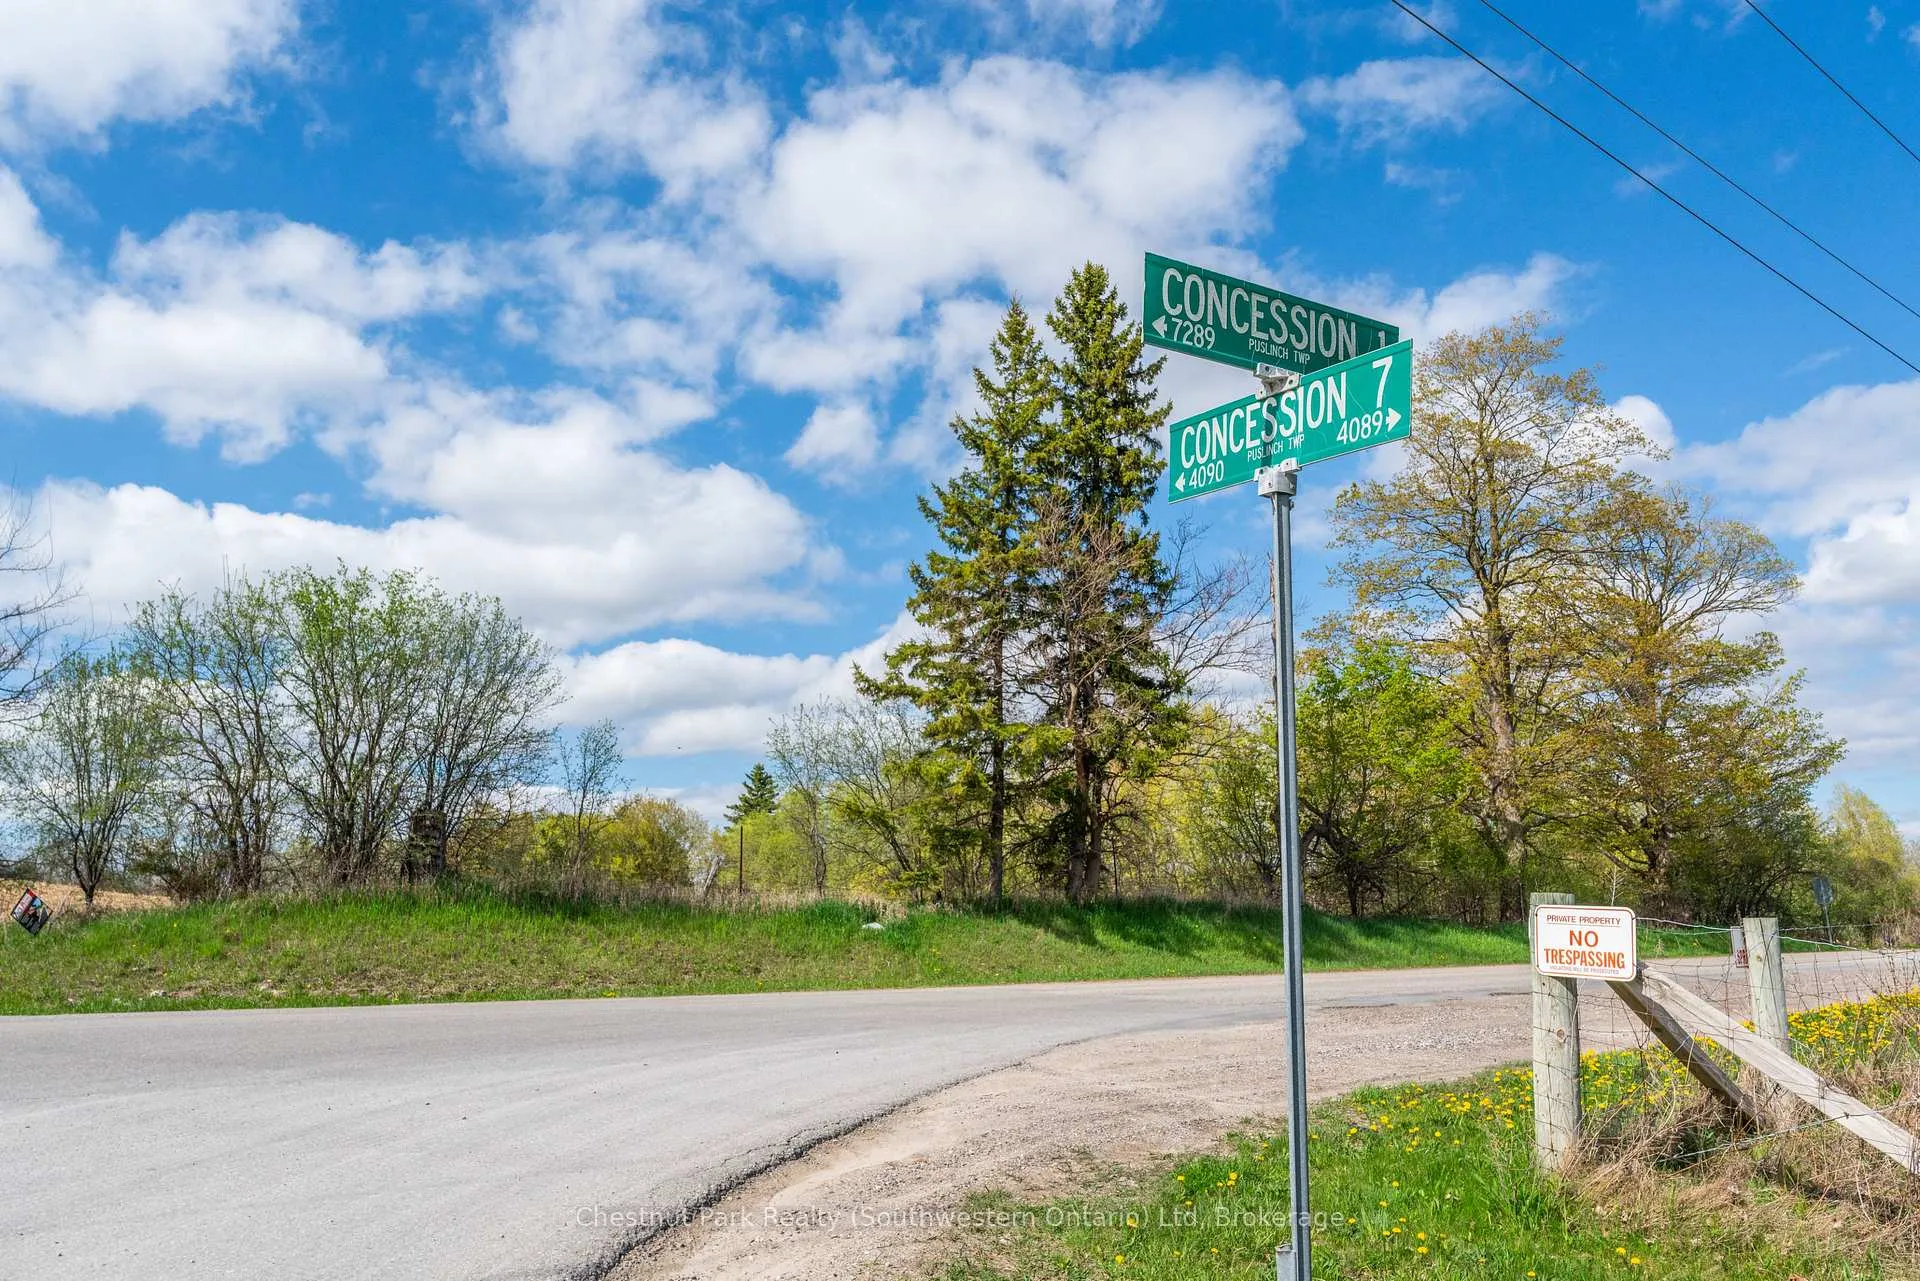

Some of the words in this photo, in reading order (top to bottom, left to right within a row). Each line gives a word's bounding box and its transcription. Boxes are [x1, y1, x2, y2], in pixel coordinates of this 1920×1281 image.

[1162, 268, 1356, 361] CONCESSION
[1171, 317, 1216, 350] 7289
[1248, 338, 1289, 360] PUSLINCH
[1293, 350, 1311, 365] TWP
[1181, 371, 1347, 469] CONCESSION
[1372, 356, 1393, 408] 7
[1336, 410, 1383, 445] 4089
[1247, 440, 1284, 463] PUSLINCH
[1289, 433, 1305, 450] TWP
[1188, 460, 1225, 489] 4090
[1546, 914, 1576, 923] PRIVATE
[1579, 915, 1621, 925] PROPERTY
[1569, 929, 1599, 947] NO
[1543, 948, 1625, 969] TRESPASSING
